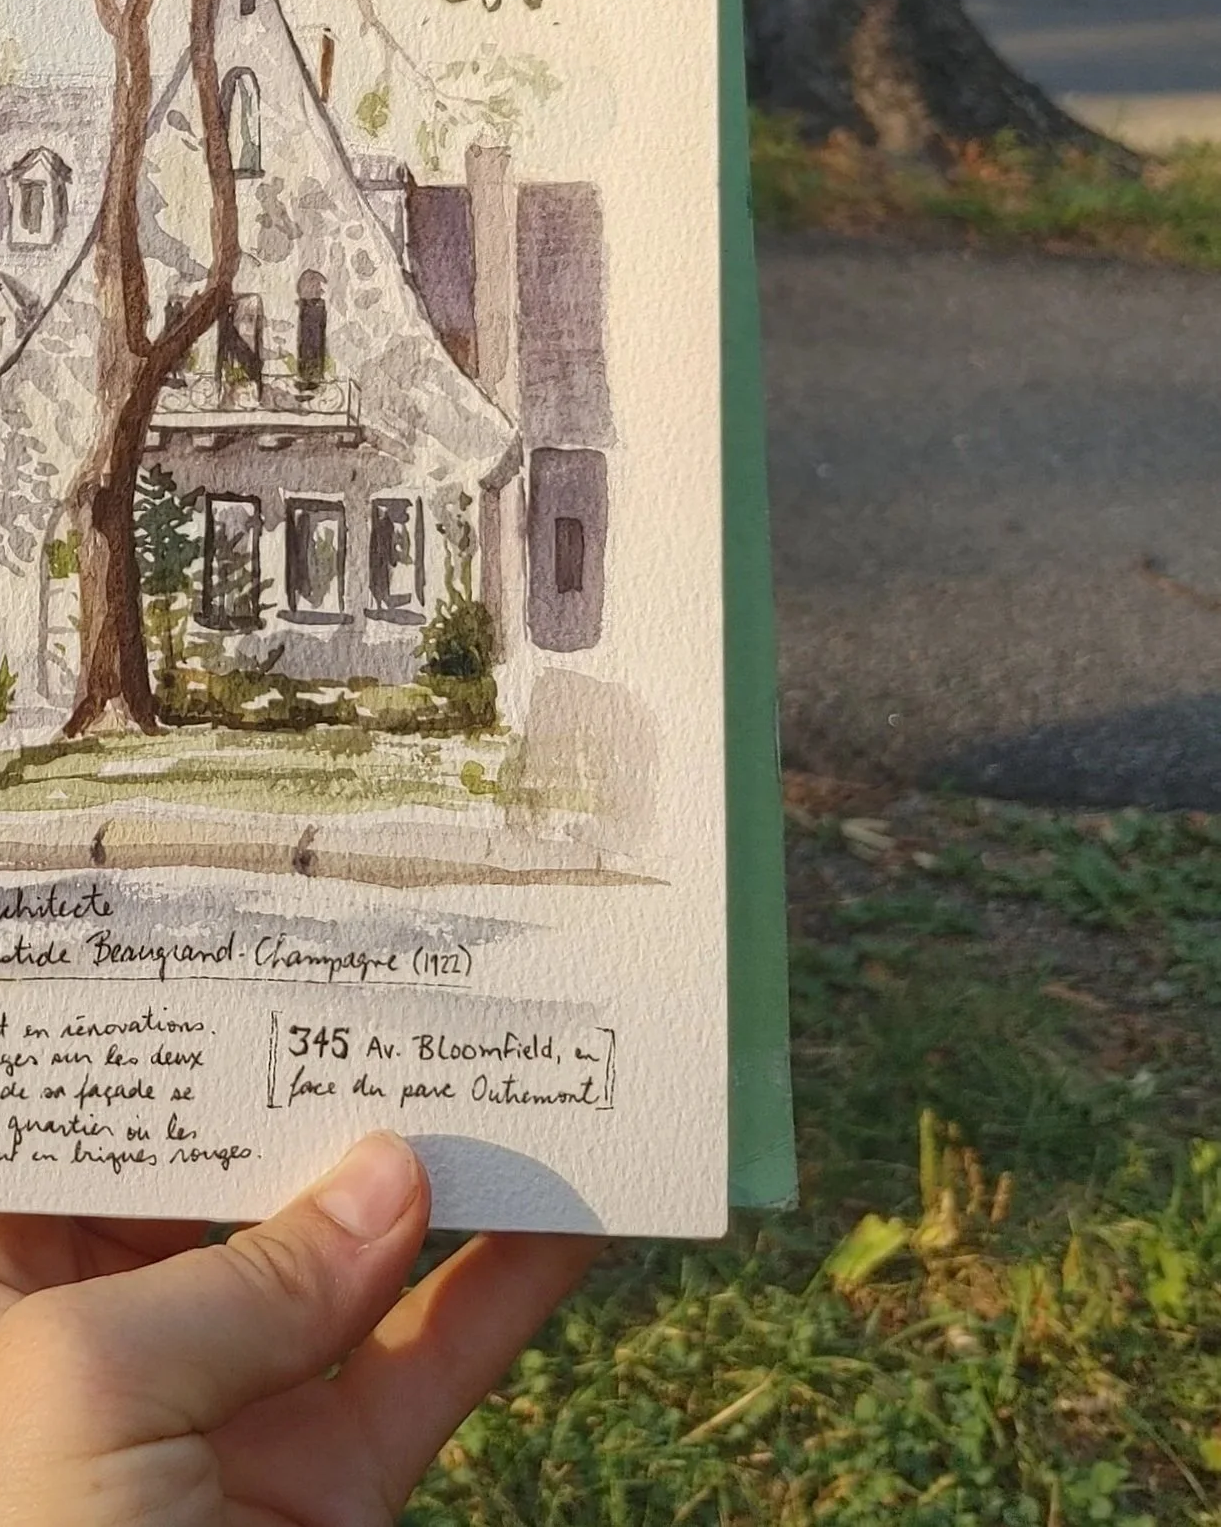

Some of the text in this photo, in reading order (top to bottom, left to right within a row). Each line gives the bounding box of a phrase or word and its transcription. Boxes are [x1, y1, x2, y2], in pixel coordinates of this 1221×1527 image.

[413, 944, 473, 977] (1922)
[24, 1022, 49, 1038] en
[60, 1006, 216, 1038] rénovations.
[51, 1052, 92, 1065] sur
[104, 1044, 139, 1067] les
[150, 1044, 205, 1069] deux
[288, 1025, 601, 1064] 345 Av. Bloomfield, en
[0, 1082, 29, 1100] de
[40, 1084, 66, 1100] sa
[74, 1073, 155, 1109] façade
[170, 1085, 196, 1101] se
[288, 1066, 600, 1107] face du parc Outremont
[7, 1114, 114, 1146] quartier
[165, 1113, 197, 1140] les
[31, 1150, 58, 1162] en
[70, 1139, 158, 1174] briques
[169, 1145, 263, 1171] rouges.
